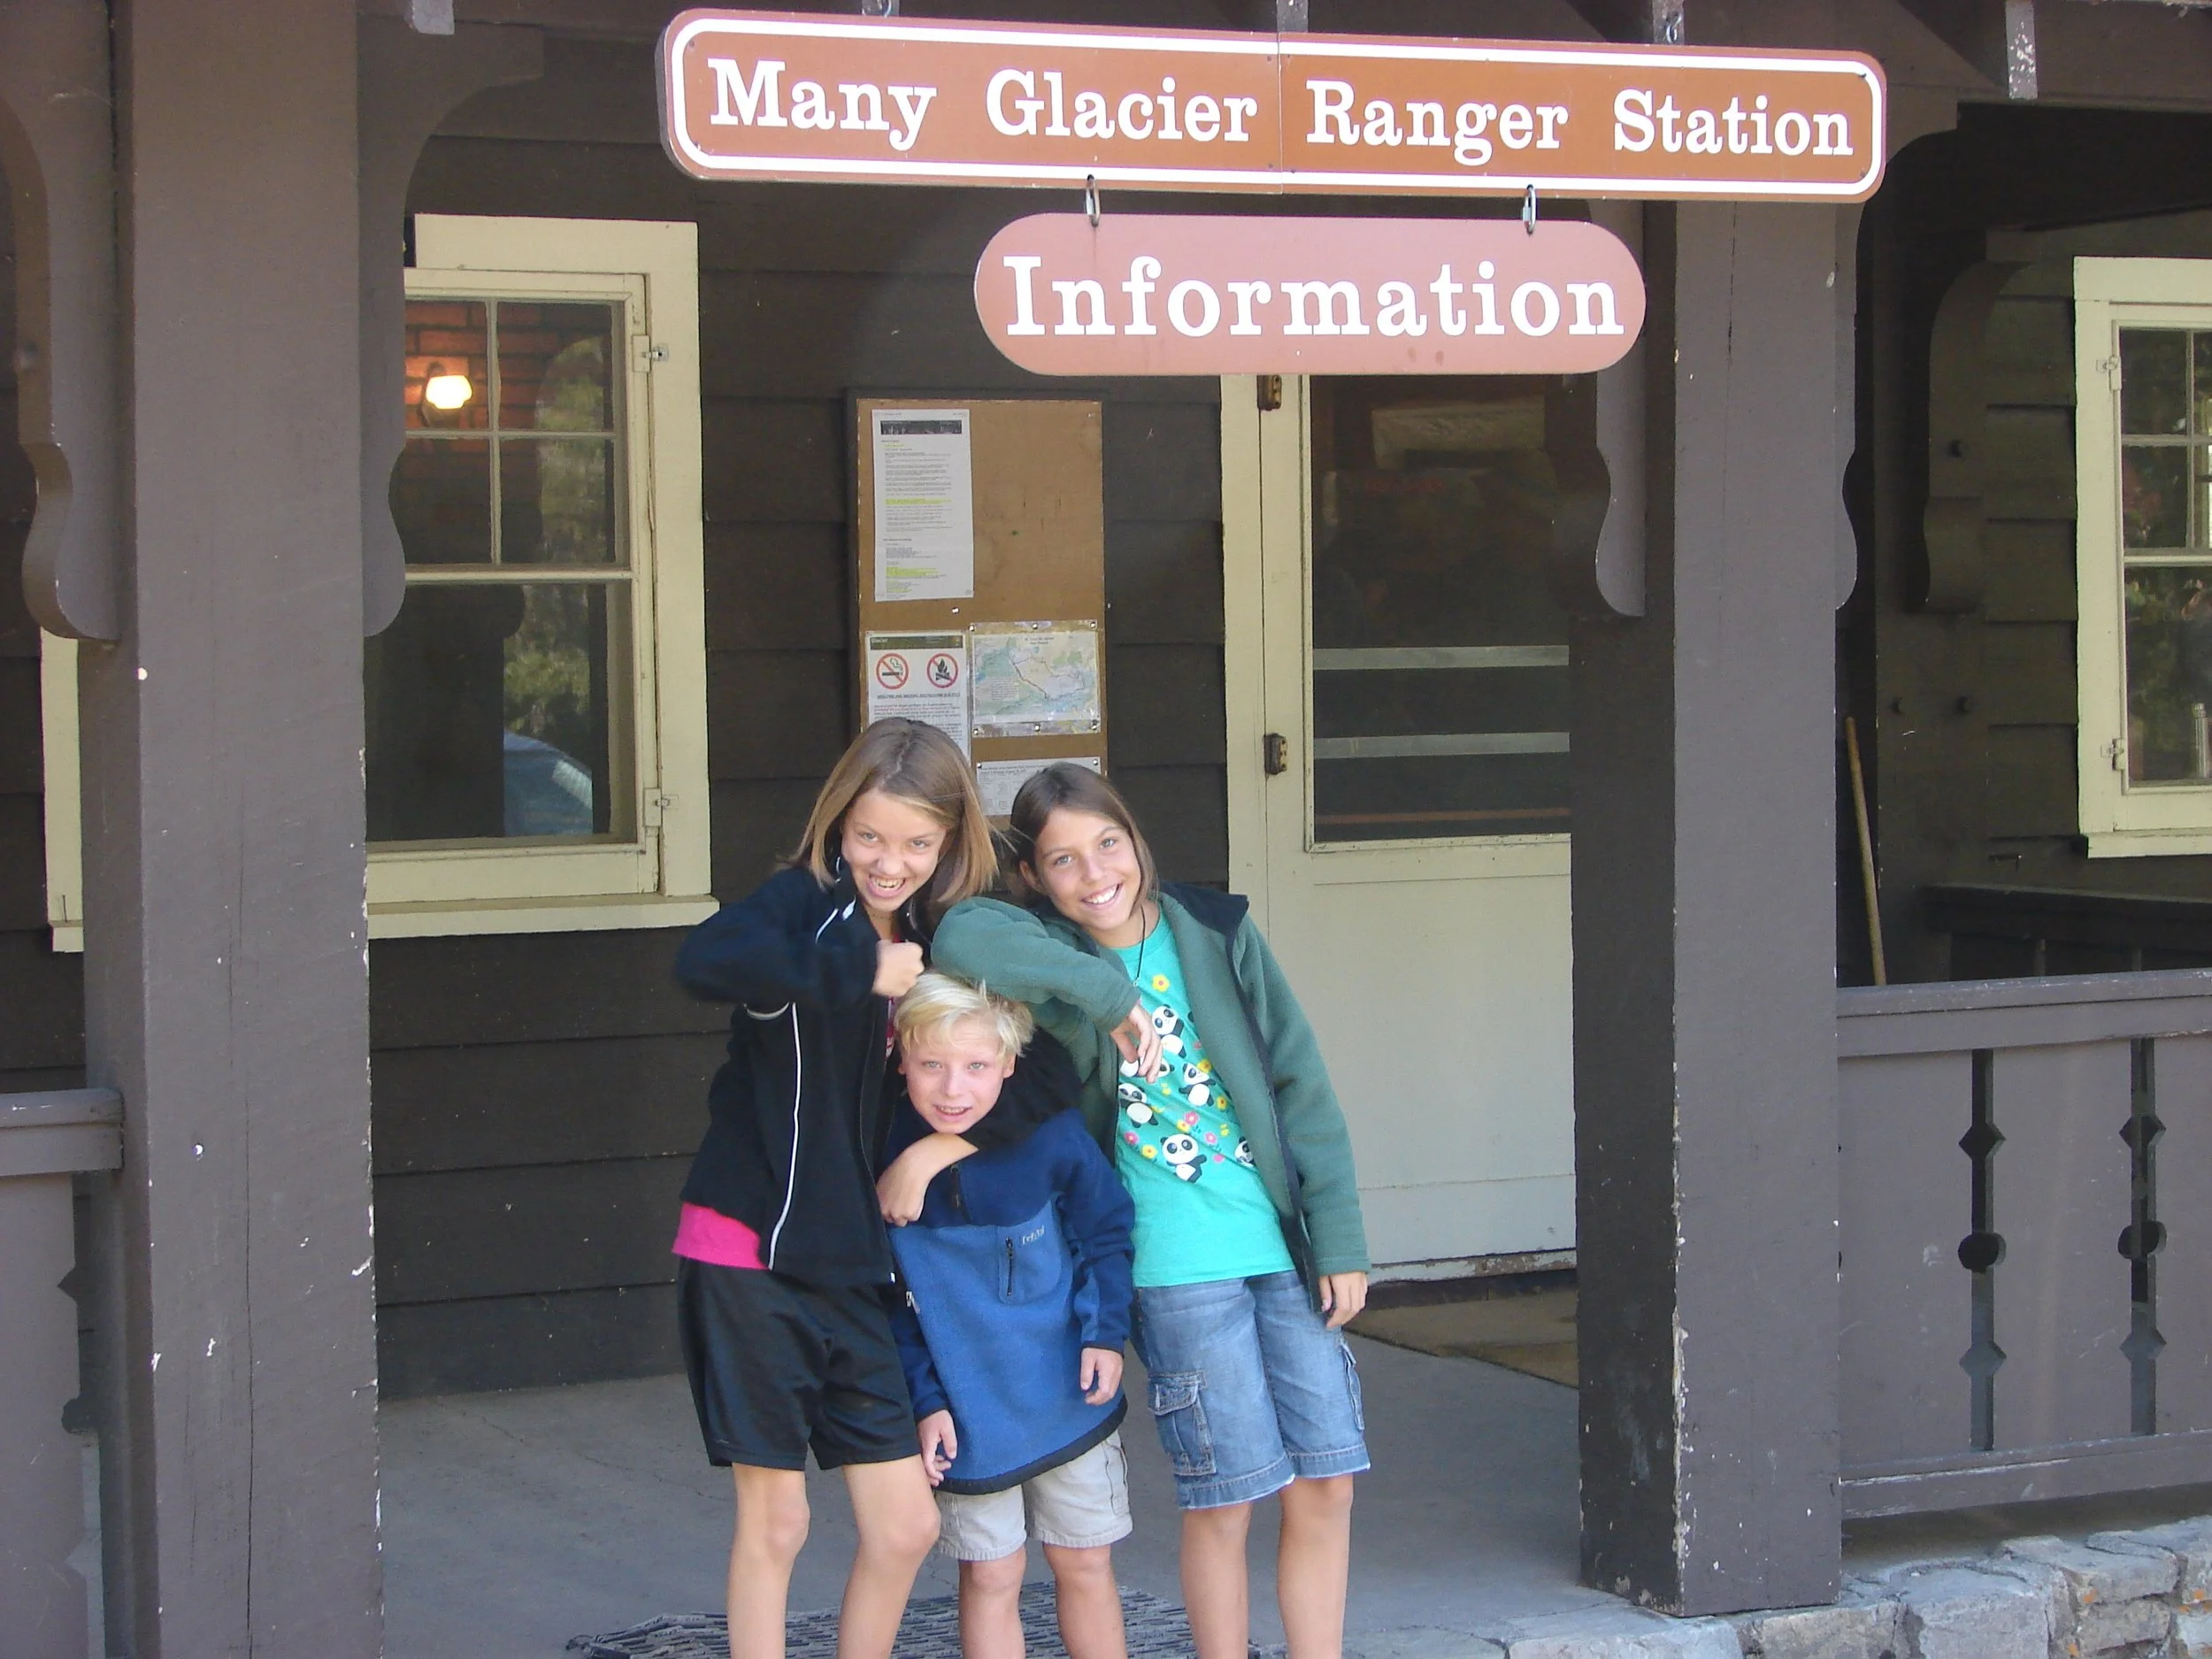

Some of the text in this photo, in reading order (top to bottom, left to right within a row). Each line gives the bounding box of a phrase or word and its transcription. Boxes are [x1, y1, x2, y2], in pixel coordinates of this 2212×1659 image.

[708, 58, 1853, 165] Many Glacier Ranger Station
[1003, 257, 1624, 336] Information
